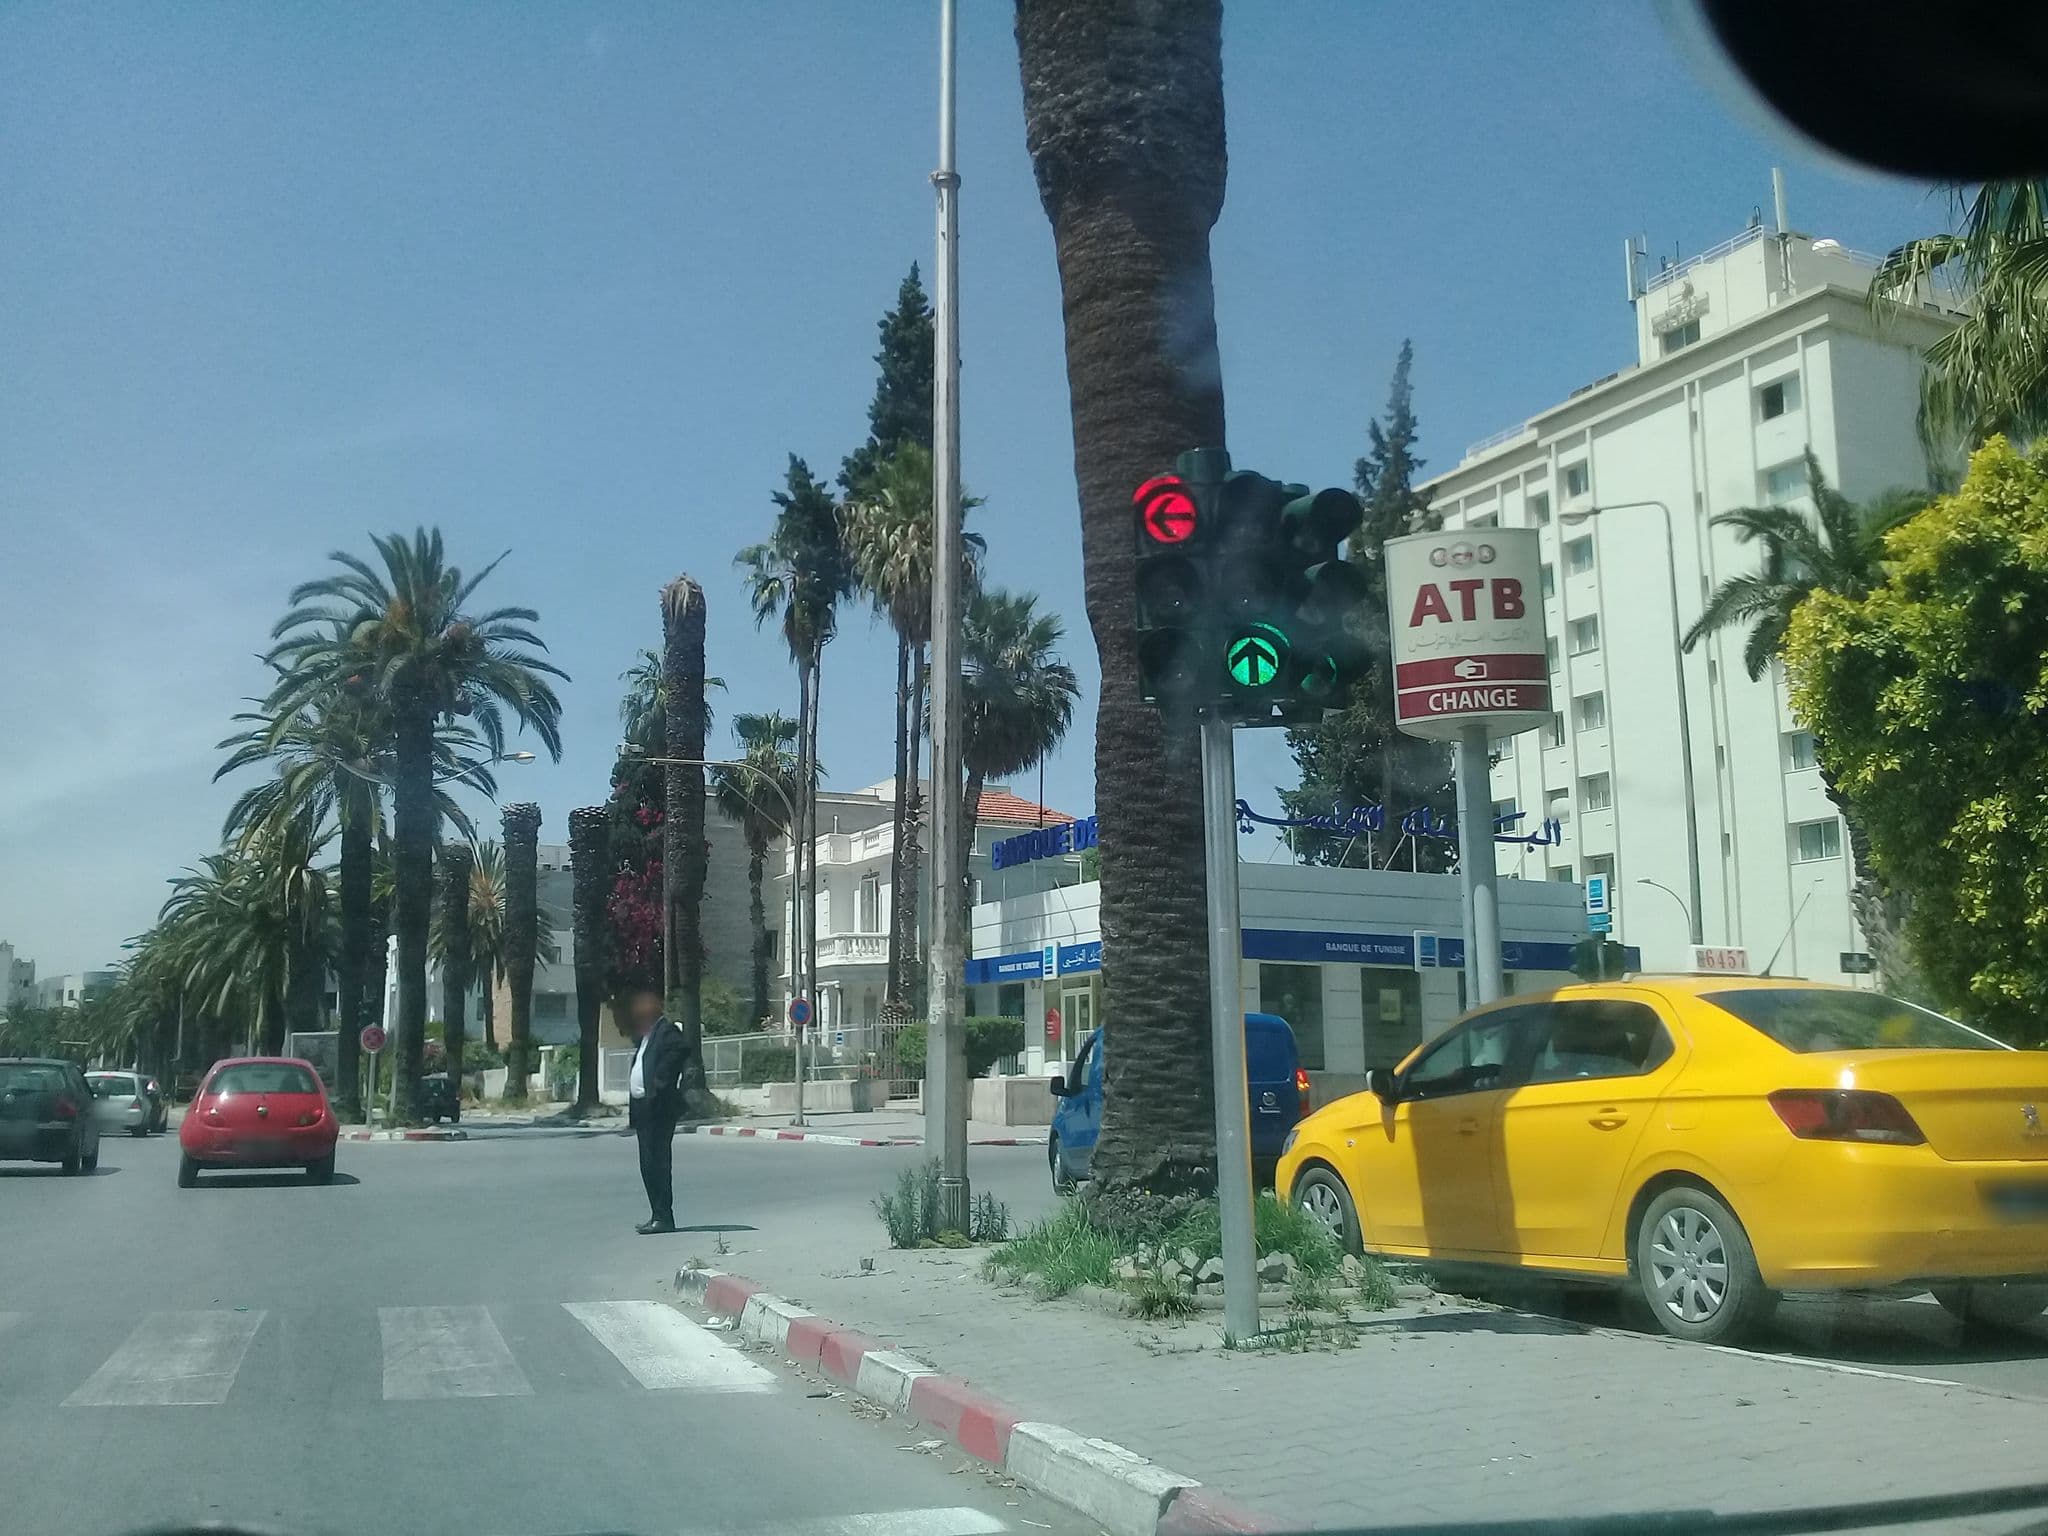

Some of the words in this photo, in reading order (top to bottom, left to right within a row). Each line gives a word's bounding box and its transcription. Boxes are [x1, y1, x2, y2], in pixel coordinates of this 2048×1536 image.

[1409, 578, 1525, 628] ATB
[1428, 688, 1518, 712] CHANGE
[1325, 942, 1360, 953] BANQUE
[1360, 943, 1372, 953] DE
[1373, 944, 1406, 955] TUNISIE
[1705, 949, 1745, 968] 6457
